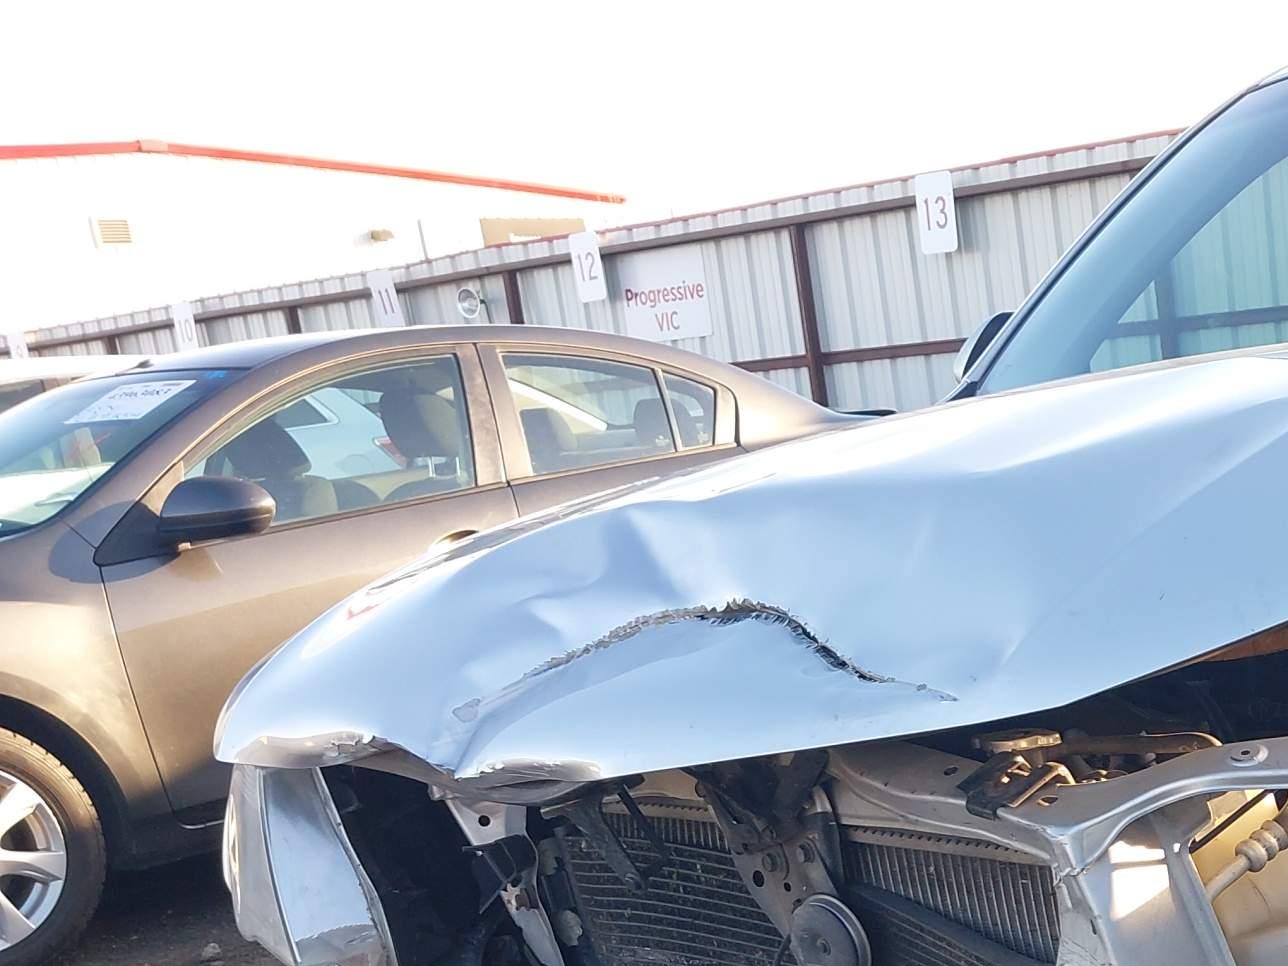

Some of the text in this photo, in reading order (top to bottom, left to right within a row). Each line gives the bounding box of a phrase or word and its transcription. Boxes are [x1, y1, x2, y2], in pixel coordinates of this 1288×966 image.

[924, 195, 948, 231] 13
[577, 251, 599, 282] 12
[378, 287, 395, 315] 11
[625, 280, 705, 308] Progressive
[655, 311, 681, 332] VIC
